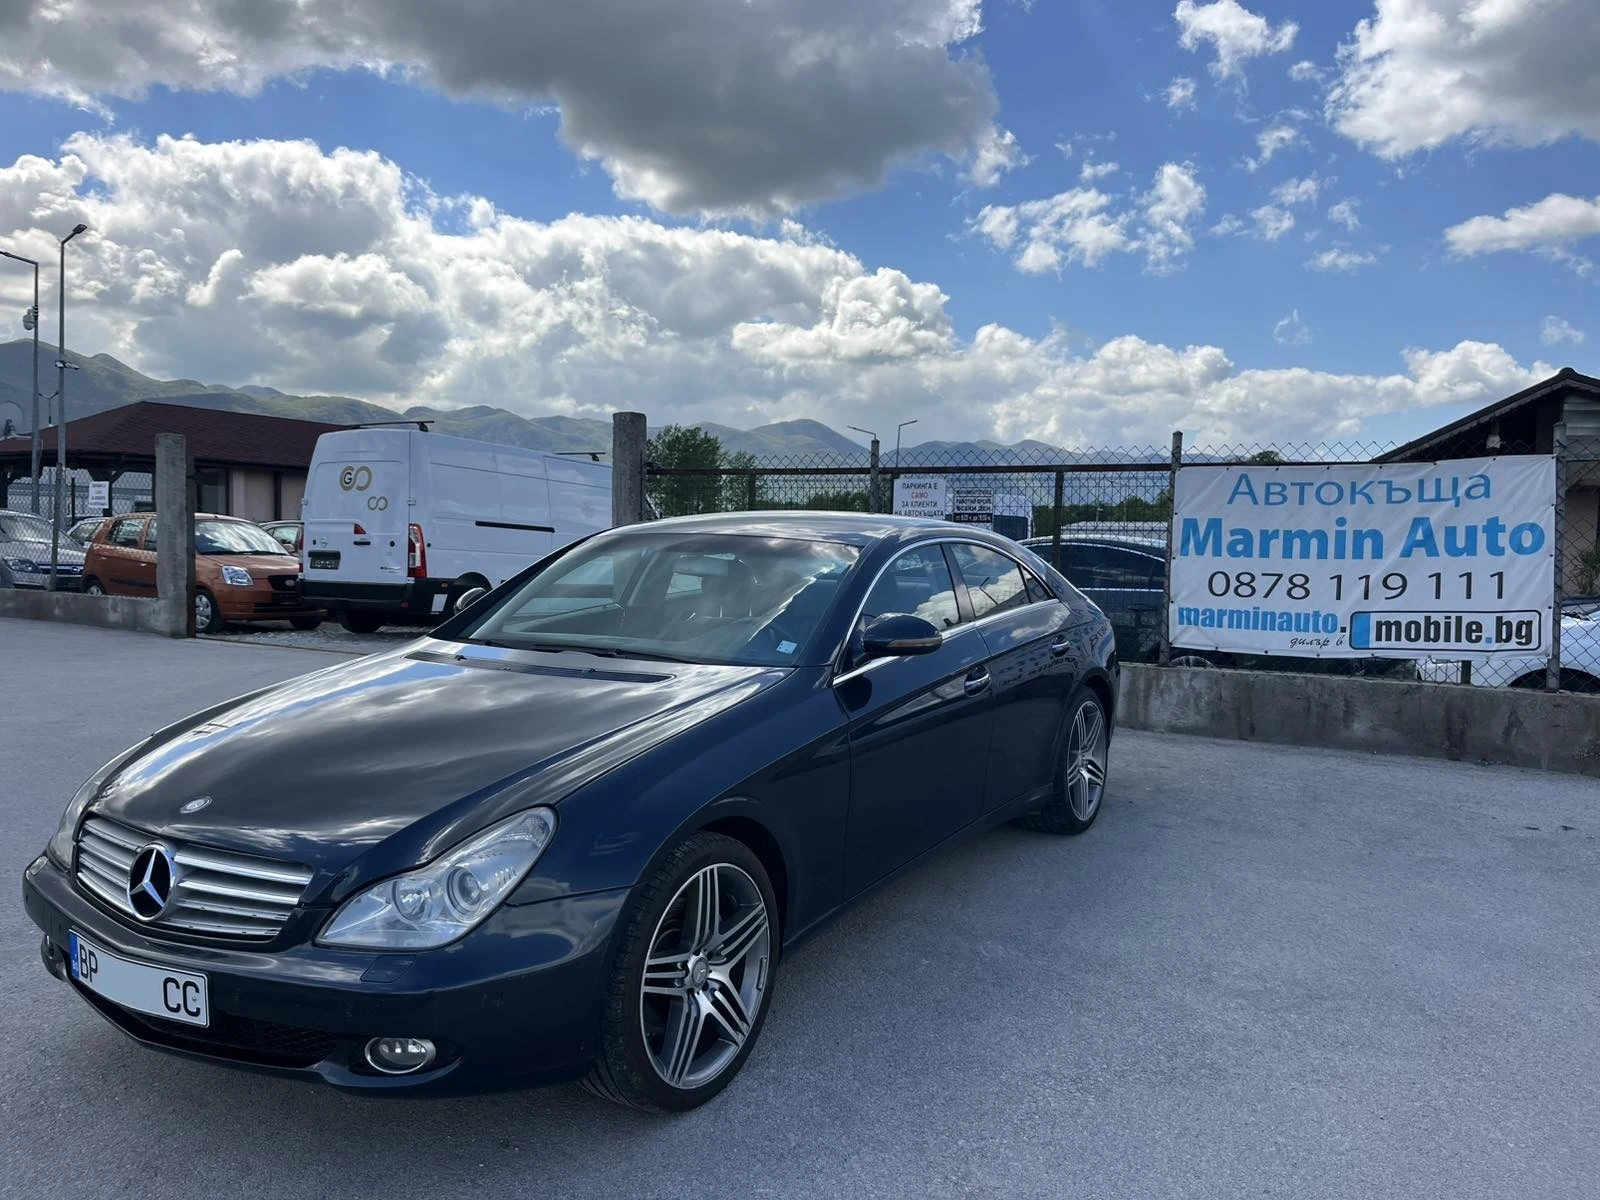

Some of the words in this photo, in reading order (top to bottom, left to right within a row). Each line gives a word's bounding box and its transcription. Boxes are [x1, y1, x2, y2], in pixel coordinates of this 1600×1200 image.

[902, 482, 932, 490] ПАРКИНГА
[911, 491, 929, 499] САМО
[1227, 473, 1492, 507] Автокъща
[904, 509, 944, 518] АВТОКЪЩАТА
[911, 500, 938, 508] КЛИЕНТИ
[1180, 516, 1384, 560] Marmin
[1399, 515, 1545, 558] Auto
[1208, 570, 1311, 601] 0878
[1329, 572, 1408, 601] 119
[1428, 571, 1505, 600] 111
[1375, 614, 1534, 647] mobile.bg
